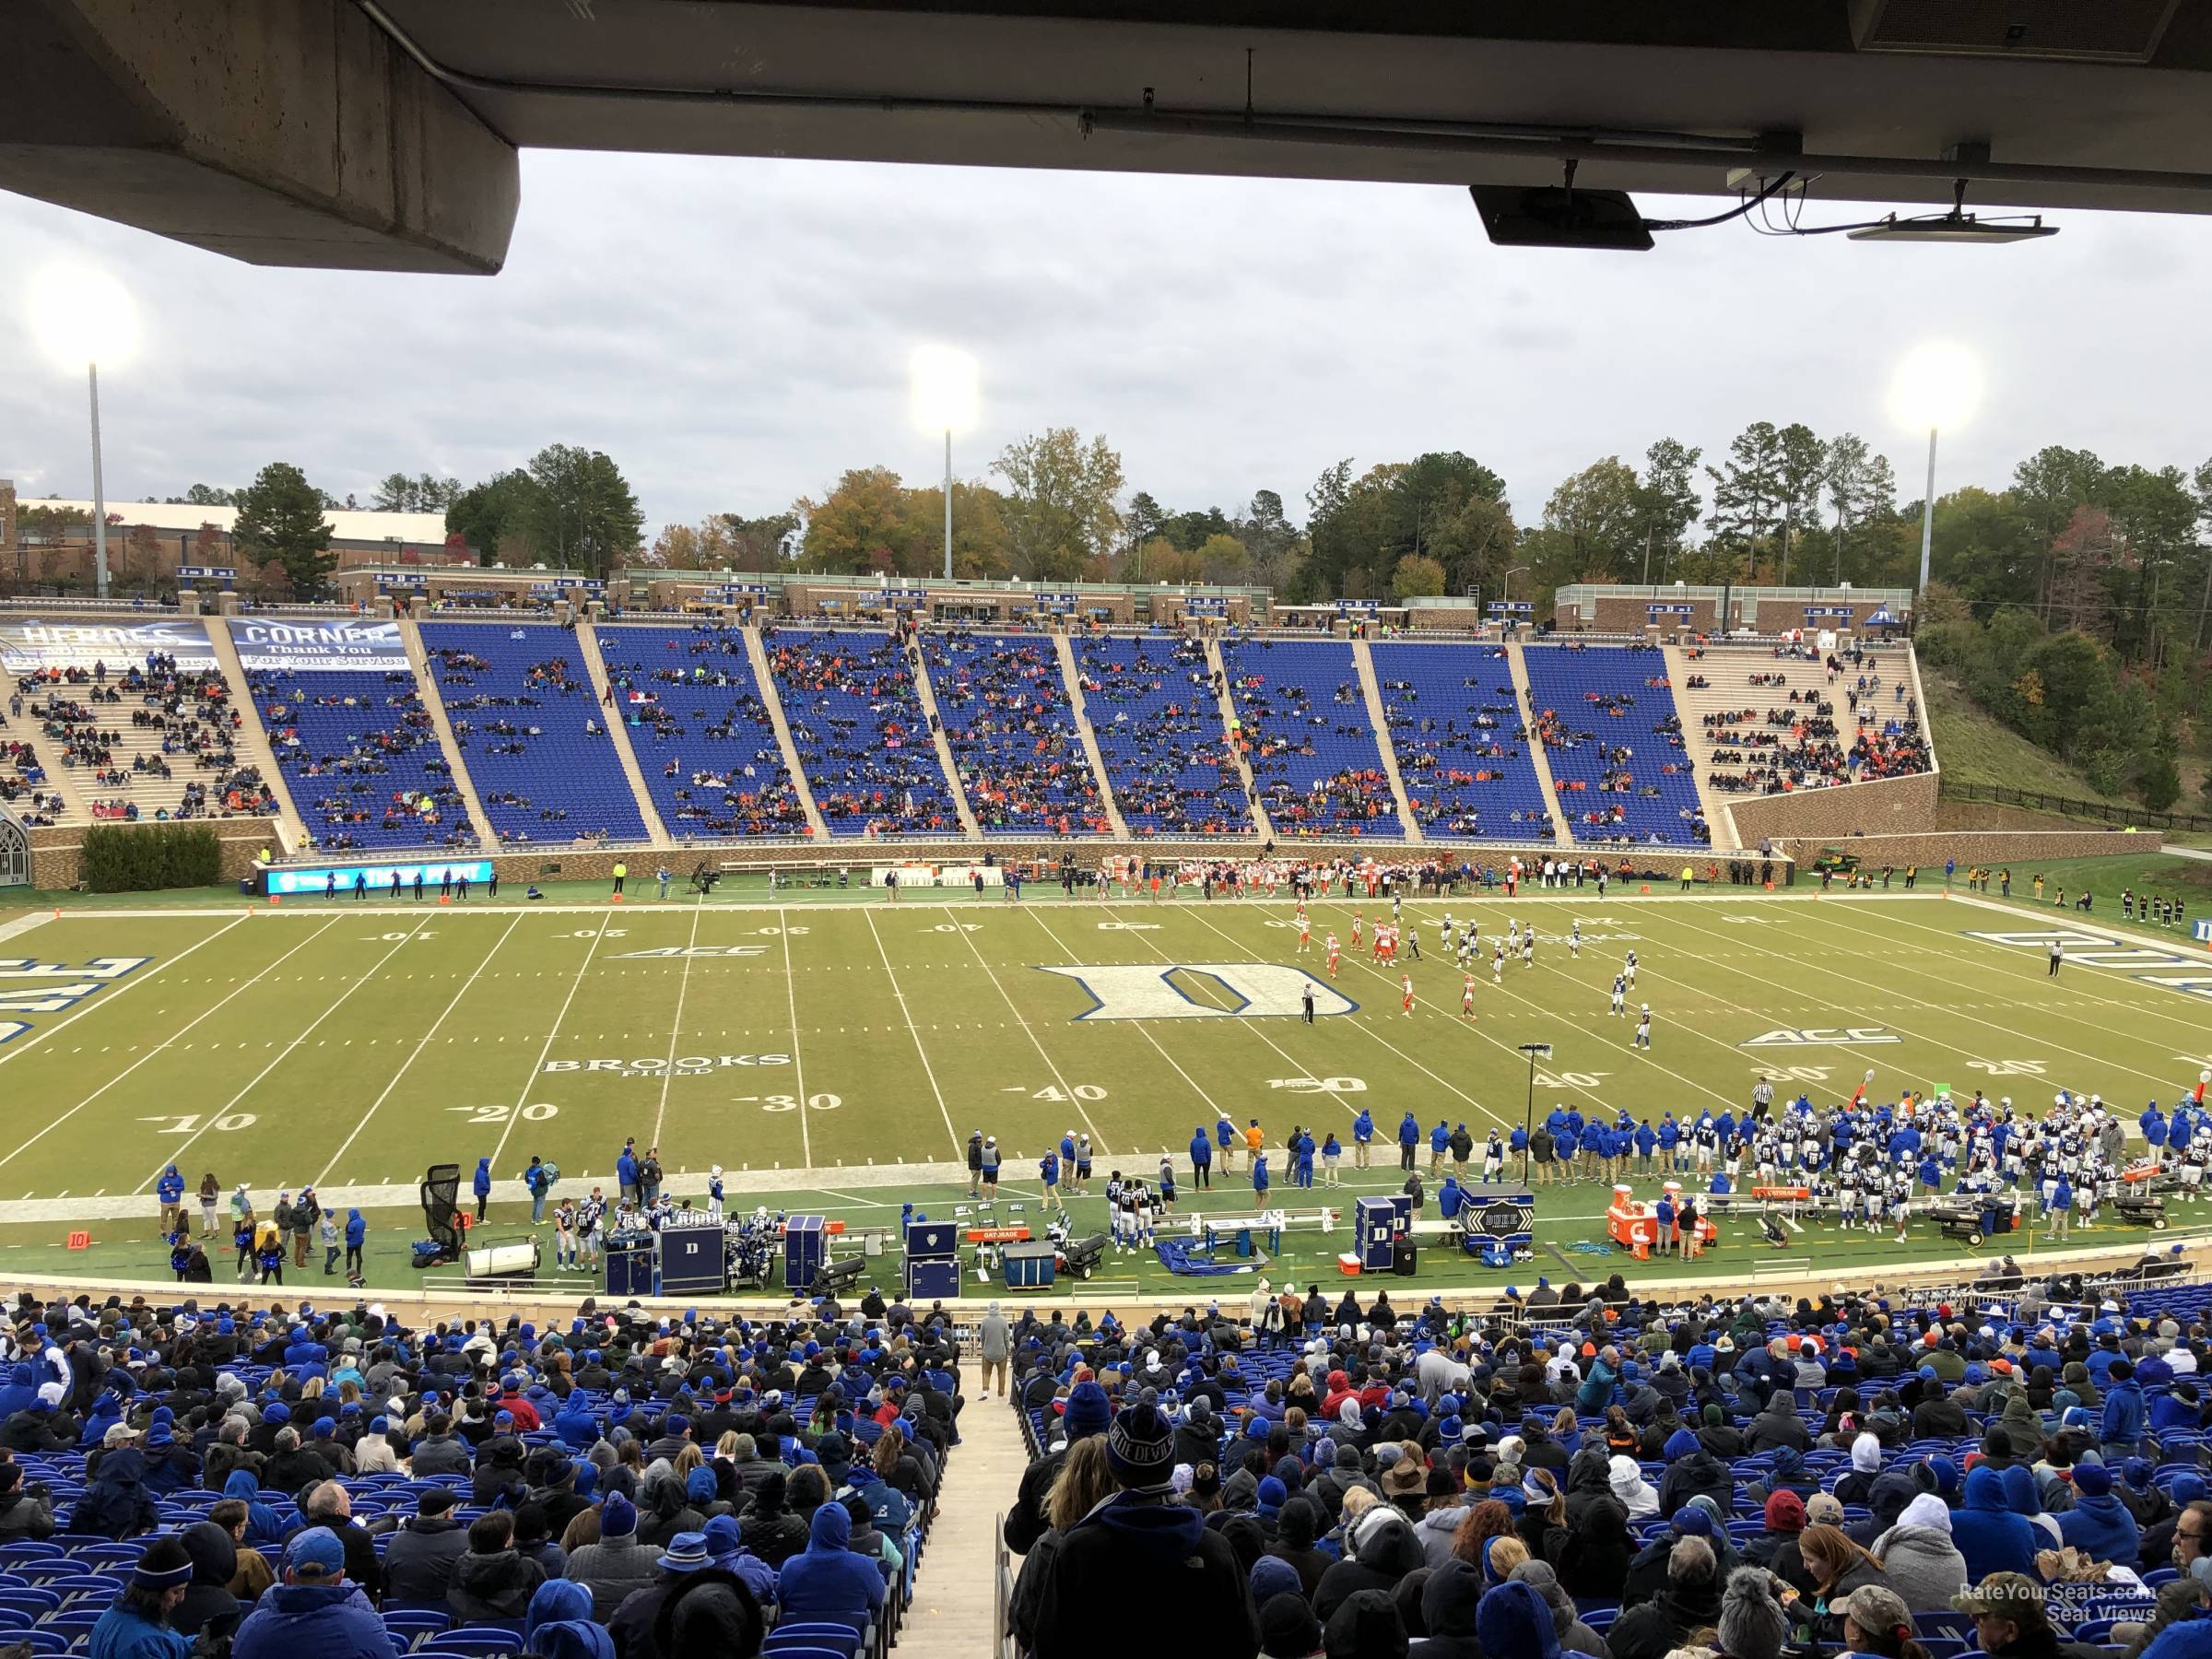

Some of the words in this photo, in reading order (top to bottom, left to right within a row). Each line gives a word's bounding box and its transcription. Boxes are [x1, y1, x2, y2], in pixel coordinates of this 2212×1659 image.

[246, 626, 390, 645] CORNER
[266, 645, 330, 655] Thank
[334, 646, 372, 655] You
[247, 655, 282, 665] For
[286, 656, 333, 665] Your
[335, 655, 406, 665] Service
[1032, 963, 1359, 1020] D
[1737, 1027, 1902, 1046] ACC
[540, 1053, 793, 1073] BROOKS
[620, 1068, 714, 1077] FIELD
[1031, 1084, 1108, 1101] 40
[762, 1093, 842, 1112] 30
[467, 1103, 559, 1123] 20
[158, 1113, 256, 1133] 10
[2191, 1150, 2206, 1161] 65
[1843, 1175, 1853, 1185] 36
[1820, 1186, 1827, 1195] 5
[622, 1218, 634, 1228] 46
[753, 1219, 765, 1230] 58
[1394, 1218, 1406, 1230] D
[1486, 1214, 1518, 1226] DUKE
[1611, 1221, 1618, 1233] G
[1630, 1221, 1645, 1236] G
[983, 1230, 1018, 1239] GATORADE
[1373, 1227, 1388, 1241] D
[71, 1234, 84, 1247] 10
[686, 1243, 699, 1253] D
[1111, 1425, 1134, 1458] BLUE
[1134, 1436, 1173, 1462] DEVILS
